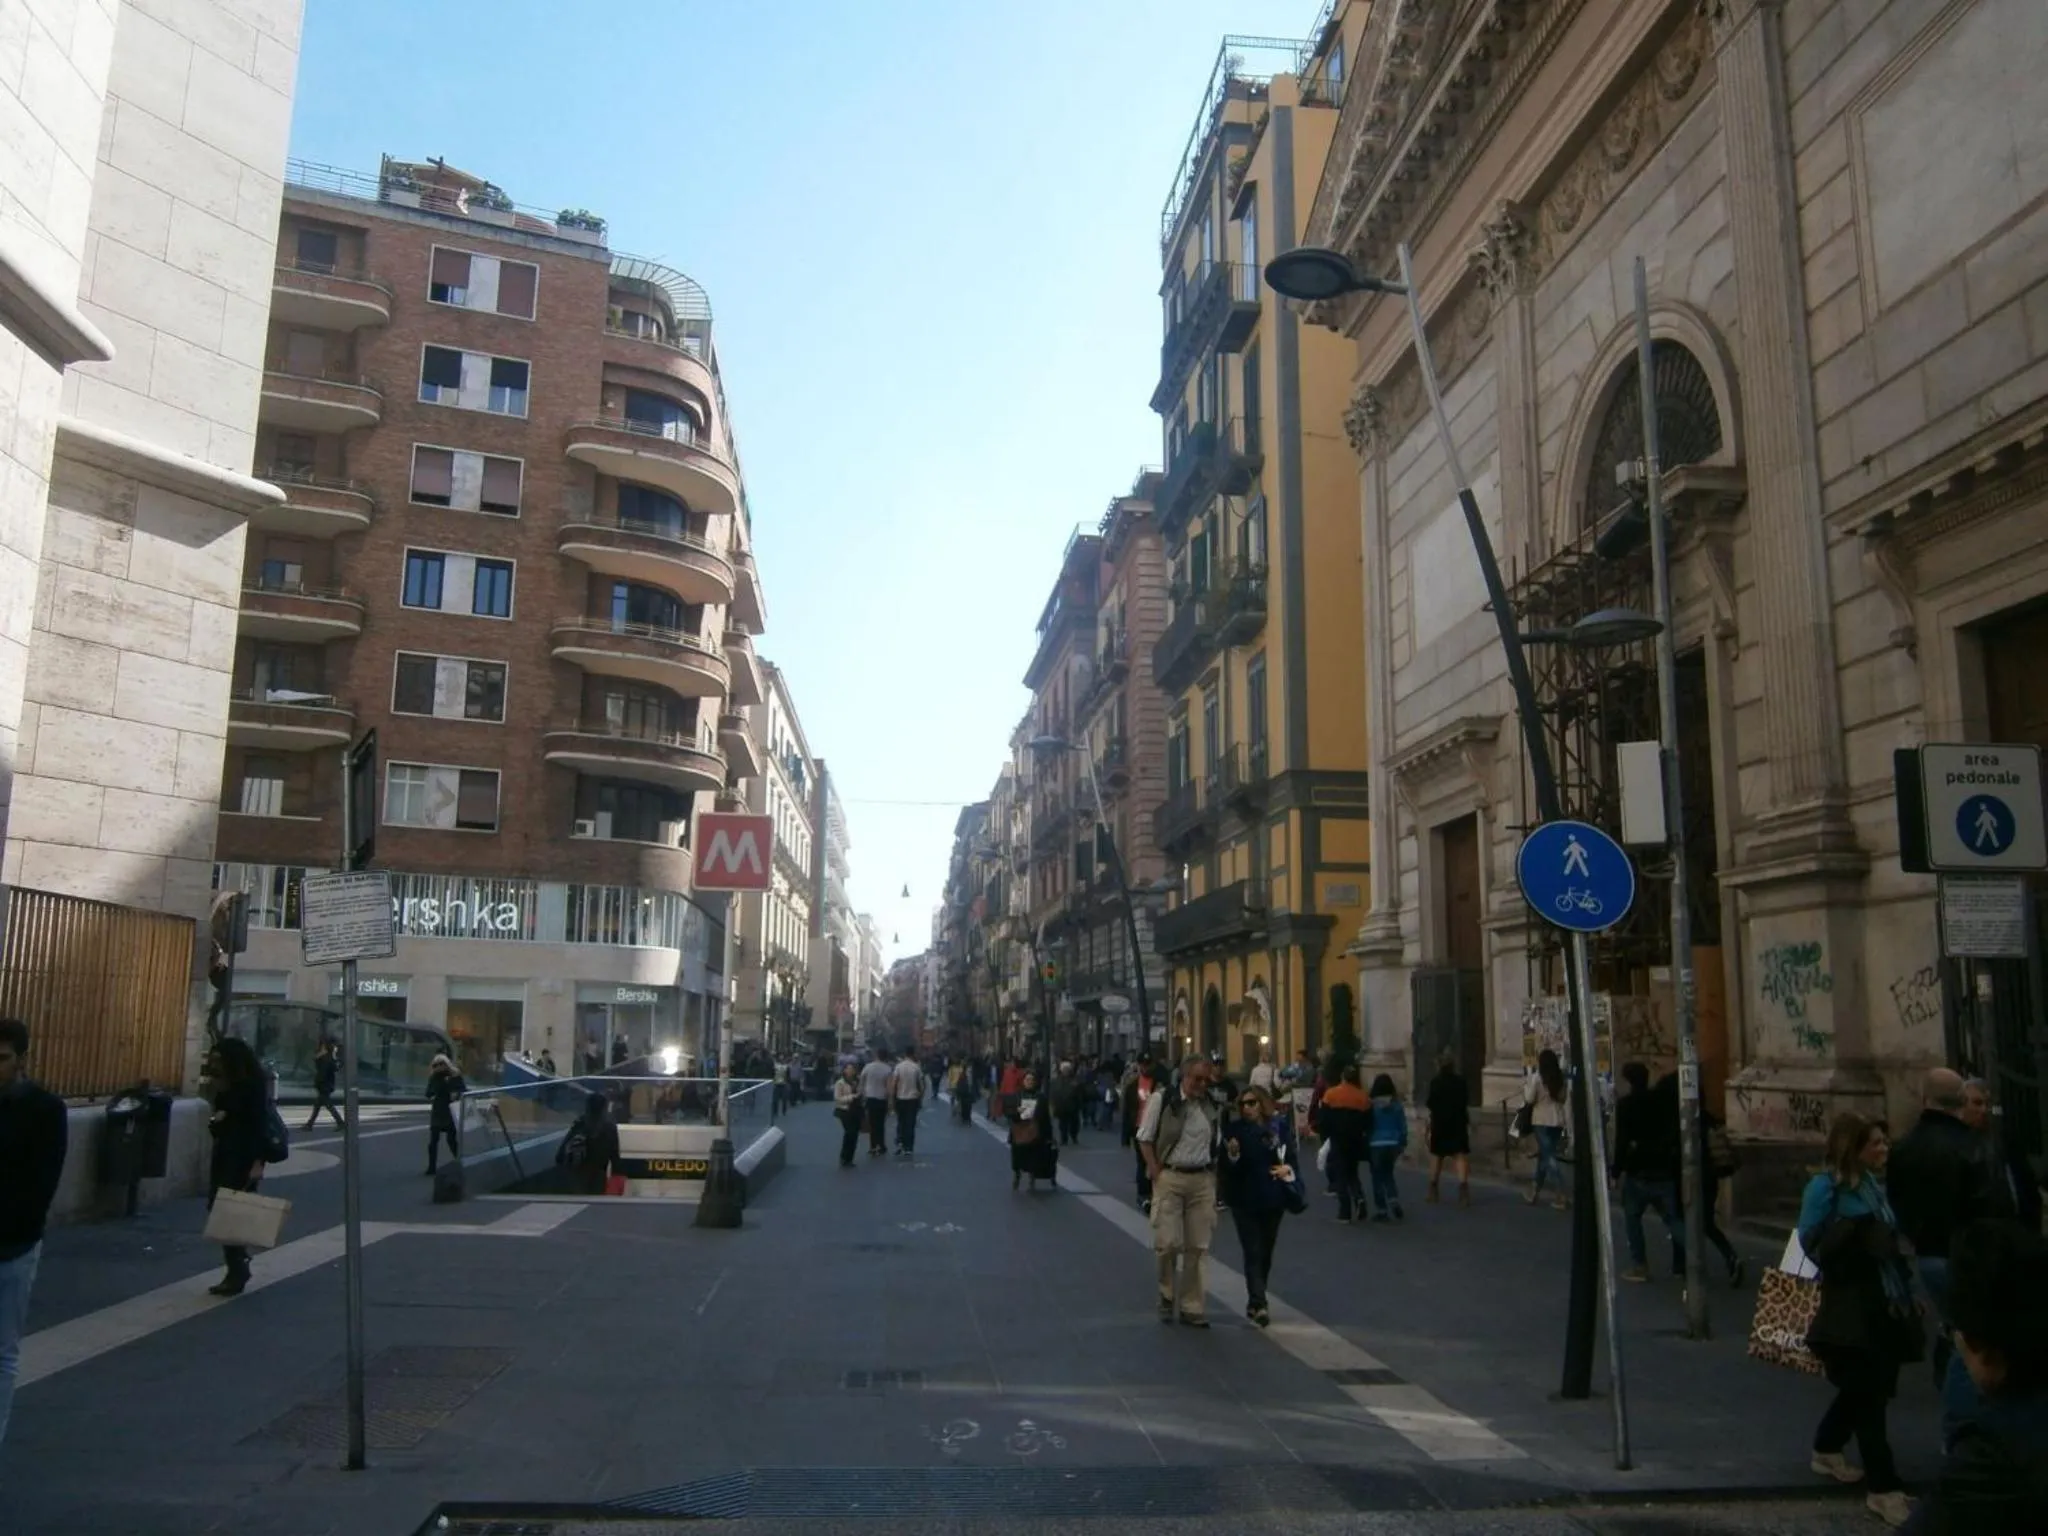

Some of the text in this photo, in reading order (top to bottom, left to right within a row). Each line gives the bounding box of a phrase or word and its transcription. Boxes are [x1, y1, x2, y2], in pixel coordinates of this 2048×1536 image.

[1964, 753, 2000, 767] area
[1946, 768, 2021, 787] pedonale
[701, 829, 764, 875] M
[339, 976, 398, 993] rshka
[616, 987, 658, 1003] Bershka
[646, 1158, 707, 1172] TOLEDO
